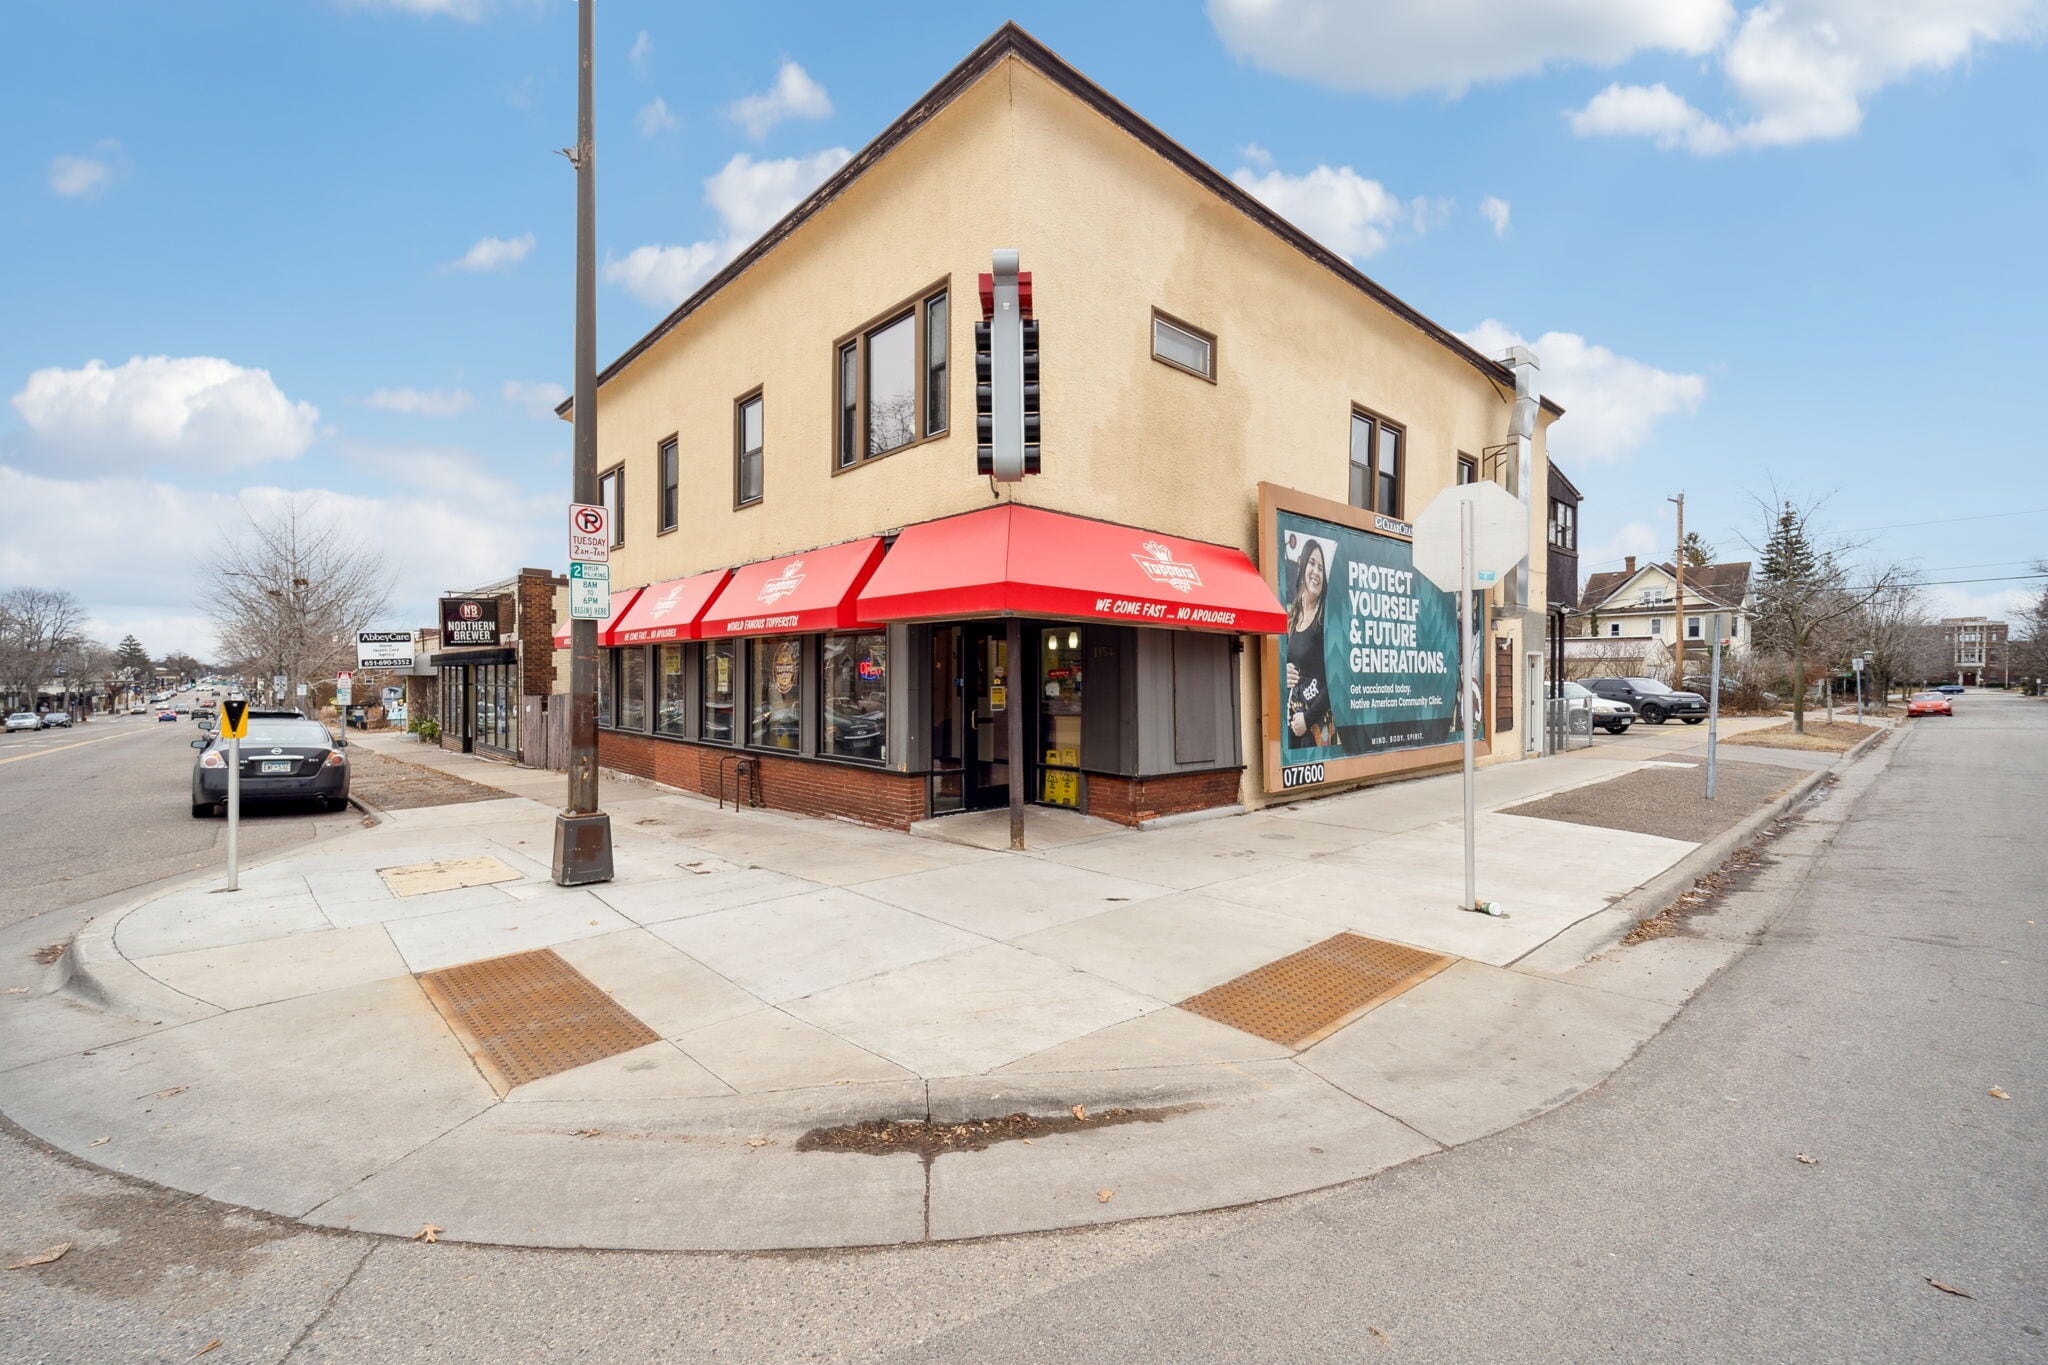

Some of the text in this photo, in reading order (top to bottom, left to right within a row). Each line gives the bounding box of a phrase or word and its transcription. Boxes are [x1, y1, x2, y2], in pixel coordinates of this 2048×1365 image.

[1382, 518, 1413, 536] CLEARCHA
[573, 536, 606, 547] TUESDAY
[574, 566, 581, 576] 2
[1348, 561, 1413, 595] PROTECT
[583, 581, 597, 589] 8AM
[464, 605, 478, 616] NB
[574, 606, 607, 615] BEGINS HERE
[1095, 598, 1112, 612] WE
[1113, 600, 1142, 615] COME
[1177, 607, 1191, 620] NO
[1191, 608, 1236, 625] APOLOGIES
[1348, 589, 1419, 622] YOURSELF
[448, 621, 495, 631] NORTHERN
[727, 615, 799, 632] WORLD FAMOUS TOPPERSTIX
[362, 633, 409, 642] AbbeyCare
[454, 631, 490, 640] BREWER
[1349, 618, 1417, 648] & FUTURE
[364, 659, 410, 667] 651-690-5352
[1349, 648, 1447, 674] GENERATIONS.
[1350, 683, 1411, 695] Get vaccinated today.
[1350, 695, 1443, 709] Native American Community Clinic.
[1371, 732, 1424, 745] MIND. BODY. SPIRIT.
[1284, 764, 1324, 787] 077600
